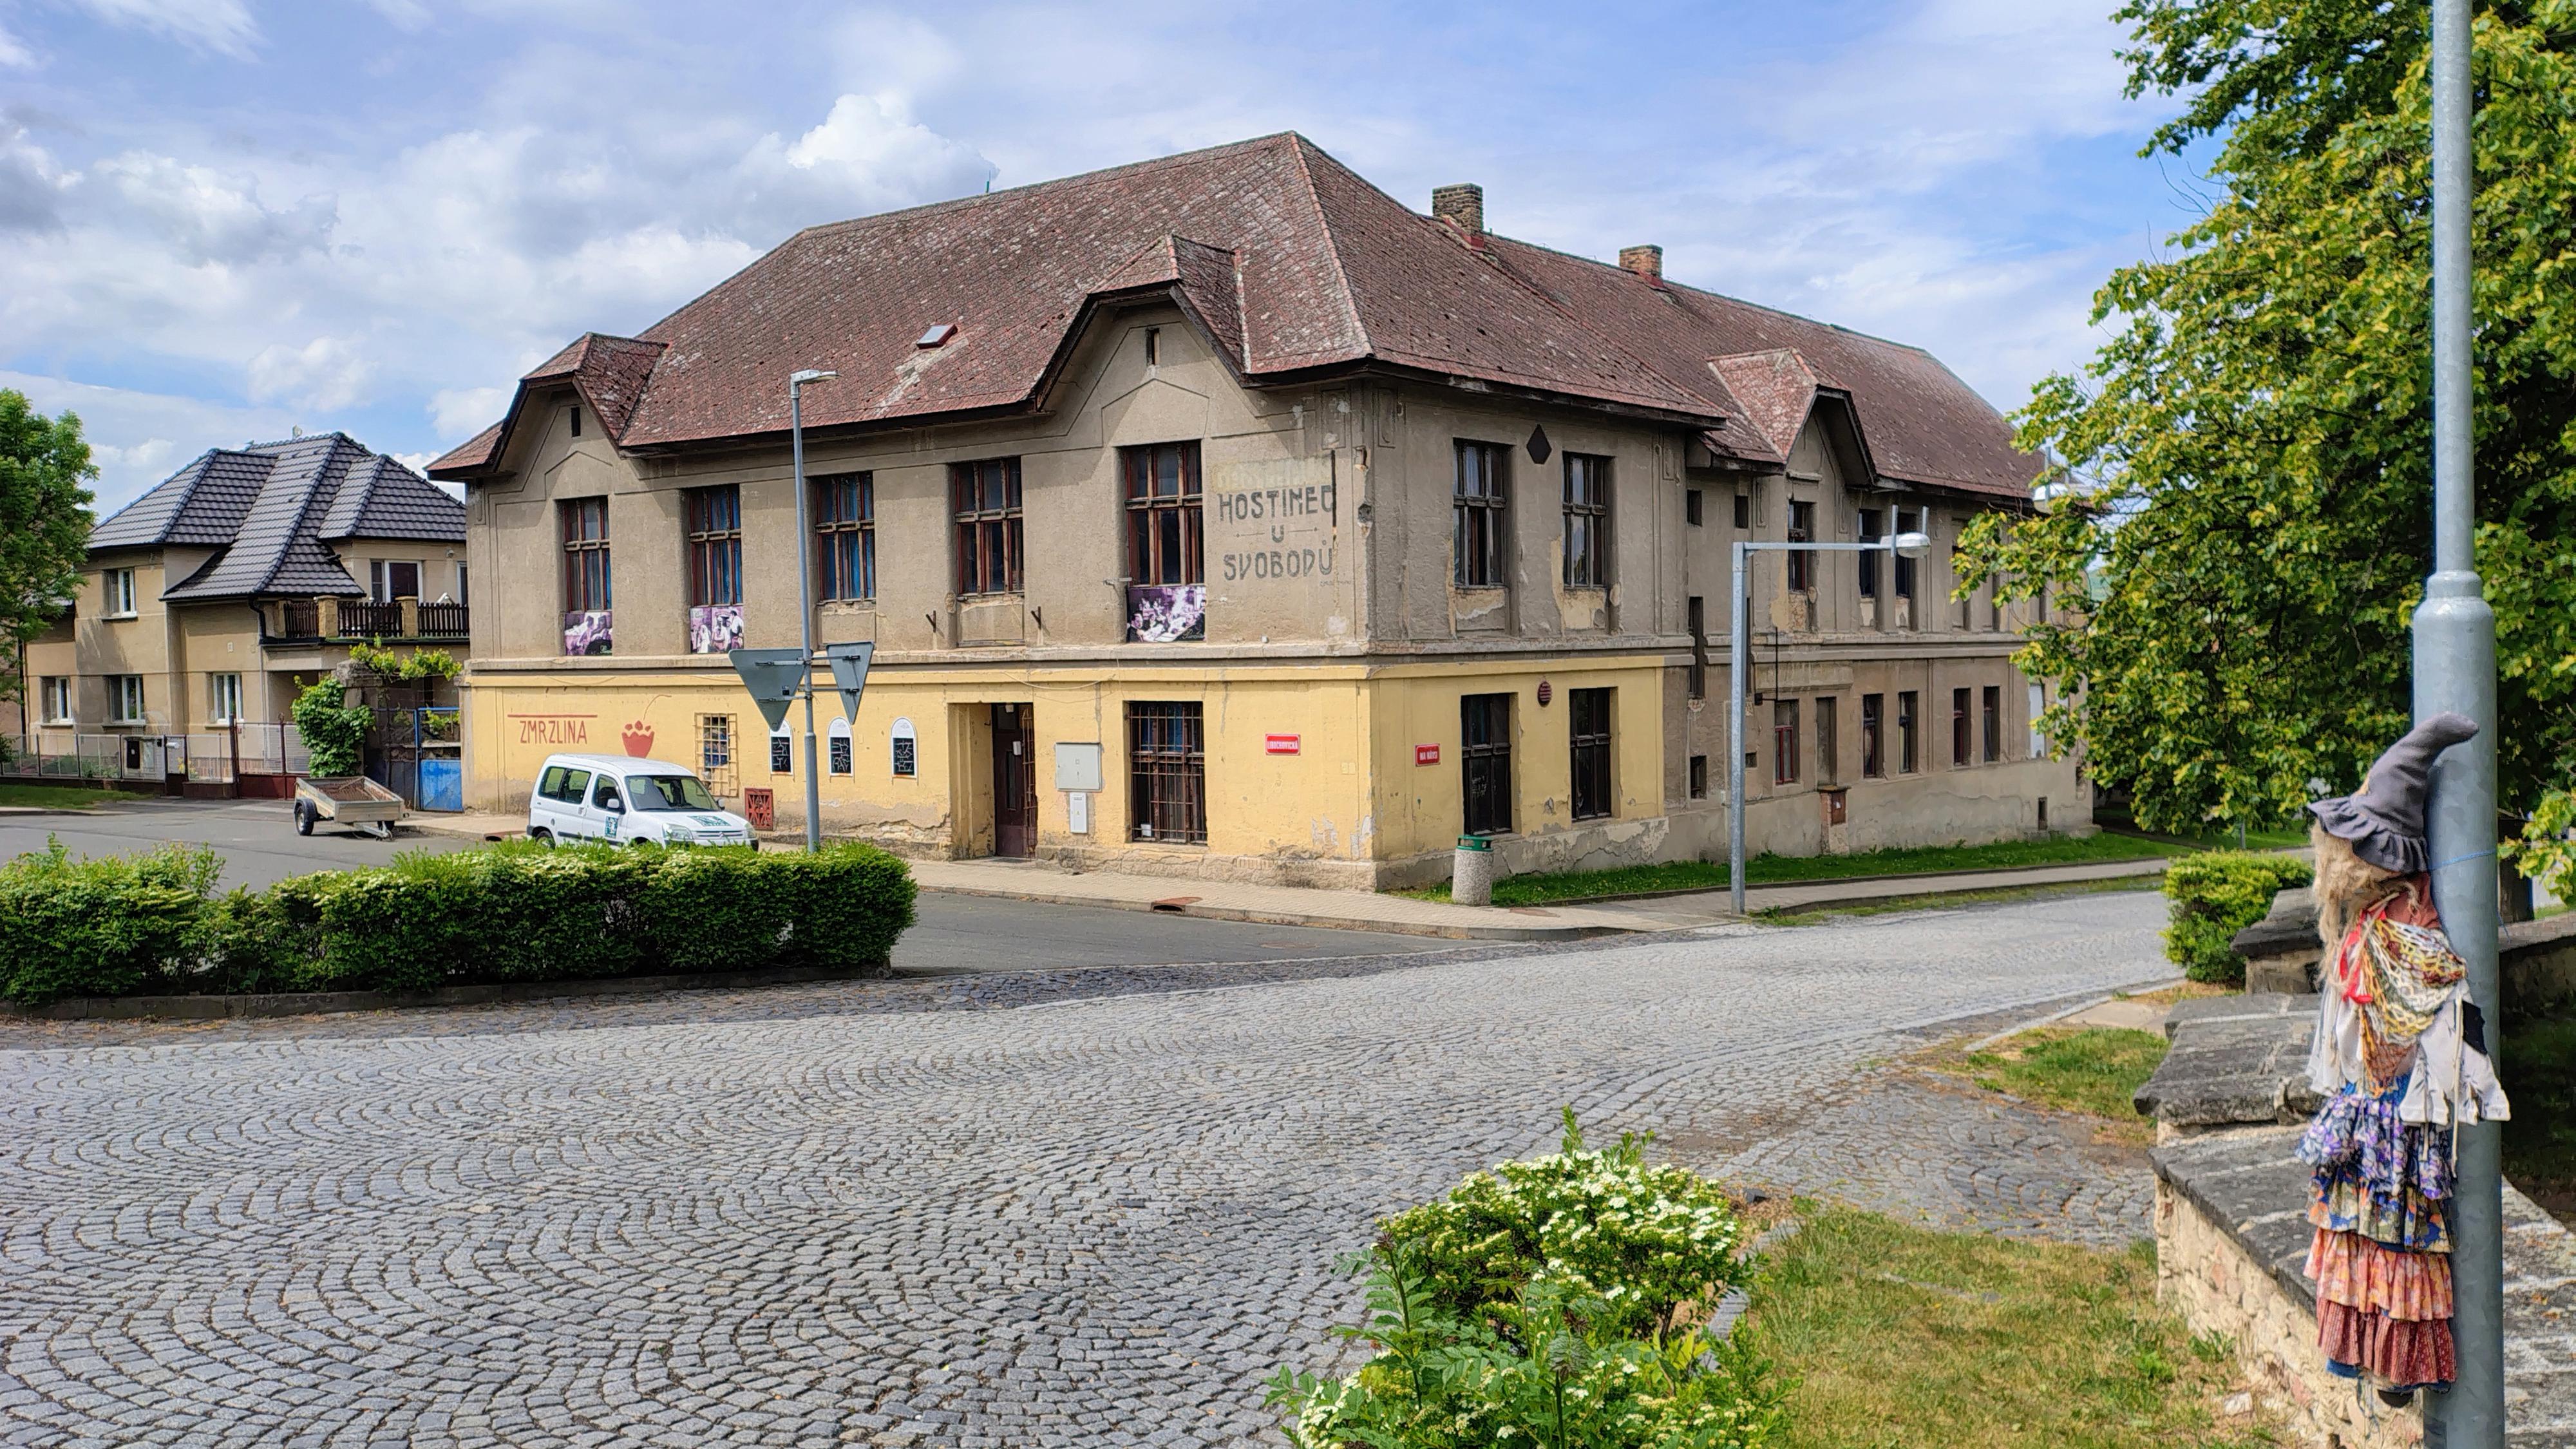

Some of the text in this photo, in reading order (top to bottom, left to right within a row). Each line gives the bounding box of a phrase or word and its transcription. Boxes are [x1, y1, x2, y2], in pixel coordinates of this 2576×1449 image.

[1218, 485, 1332, 524] HOSTINEC
[1271, 524, 1285, 543] U
[1224, 540, 1333, 580] SVOBODŮ
[520, 720, 587, 744] ZMRZLINA
